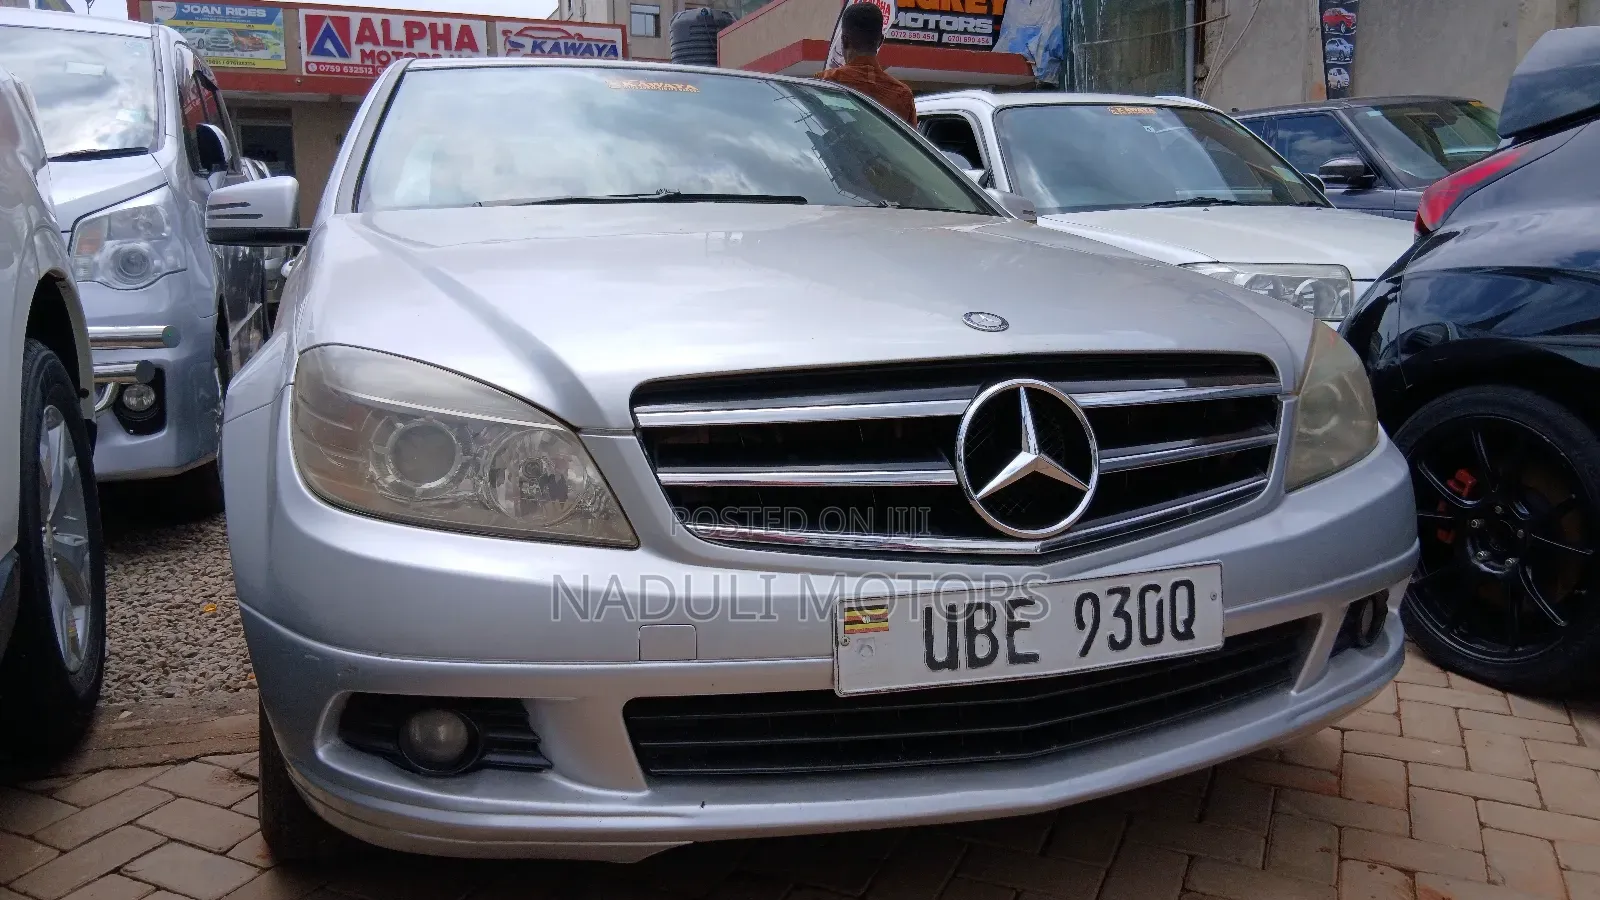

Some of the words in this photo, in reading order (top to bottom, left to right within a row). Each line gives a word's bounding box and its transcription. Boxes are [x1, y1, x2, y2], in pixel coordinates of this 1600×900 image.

[182, 4, 221, 15] JOAN
[226, 7, 266, 18] RIDES
[355, 17, 479, 52] ALPHA
[531, 40, 619, 57] KAWAYA
[319, 65, 340, 73] 0759
[343, 66, 373, 75] 632512
[922, 596, 1041, 672] UBE
[1073, 578, 1197, 658] 930Q
